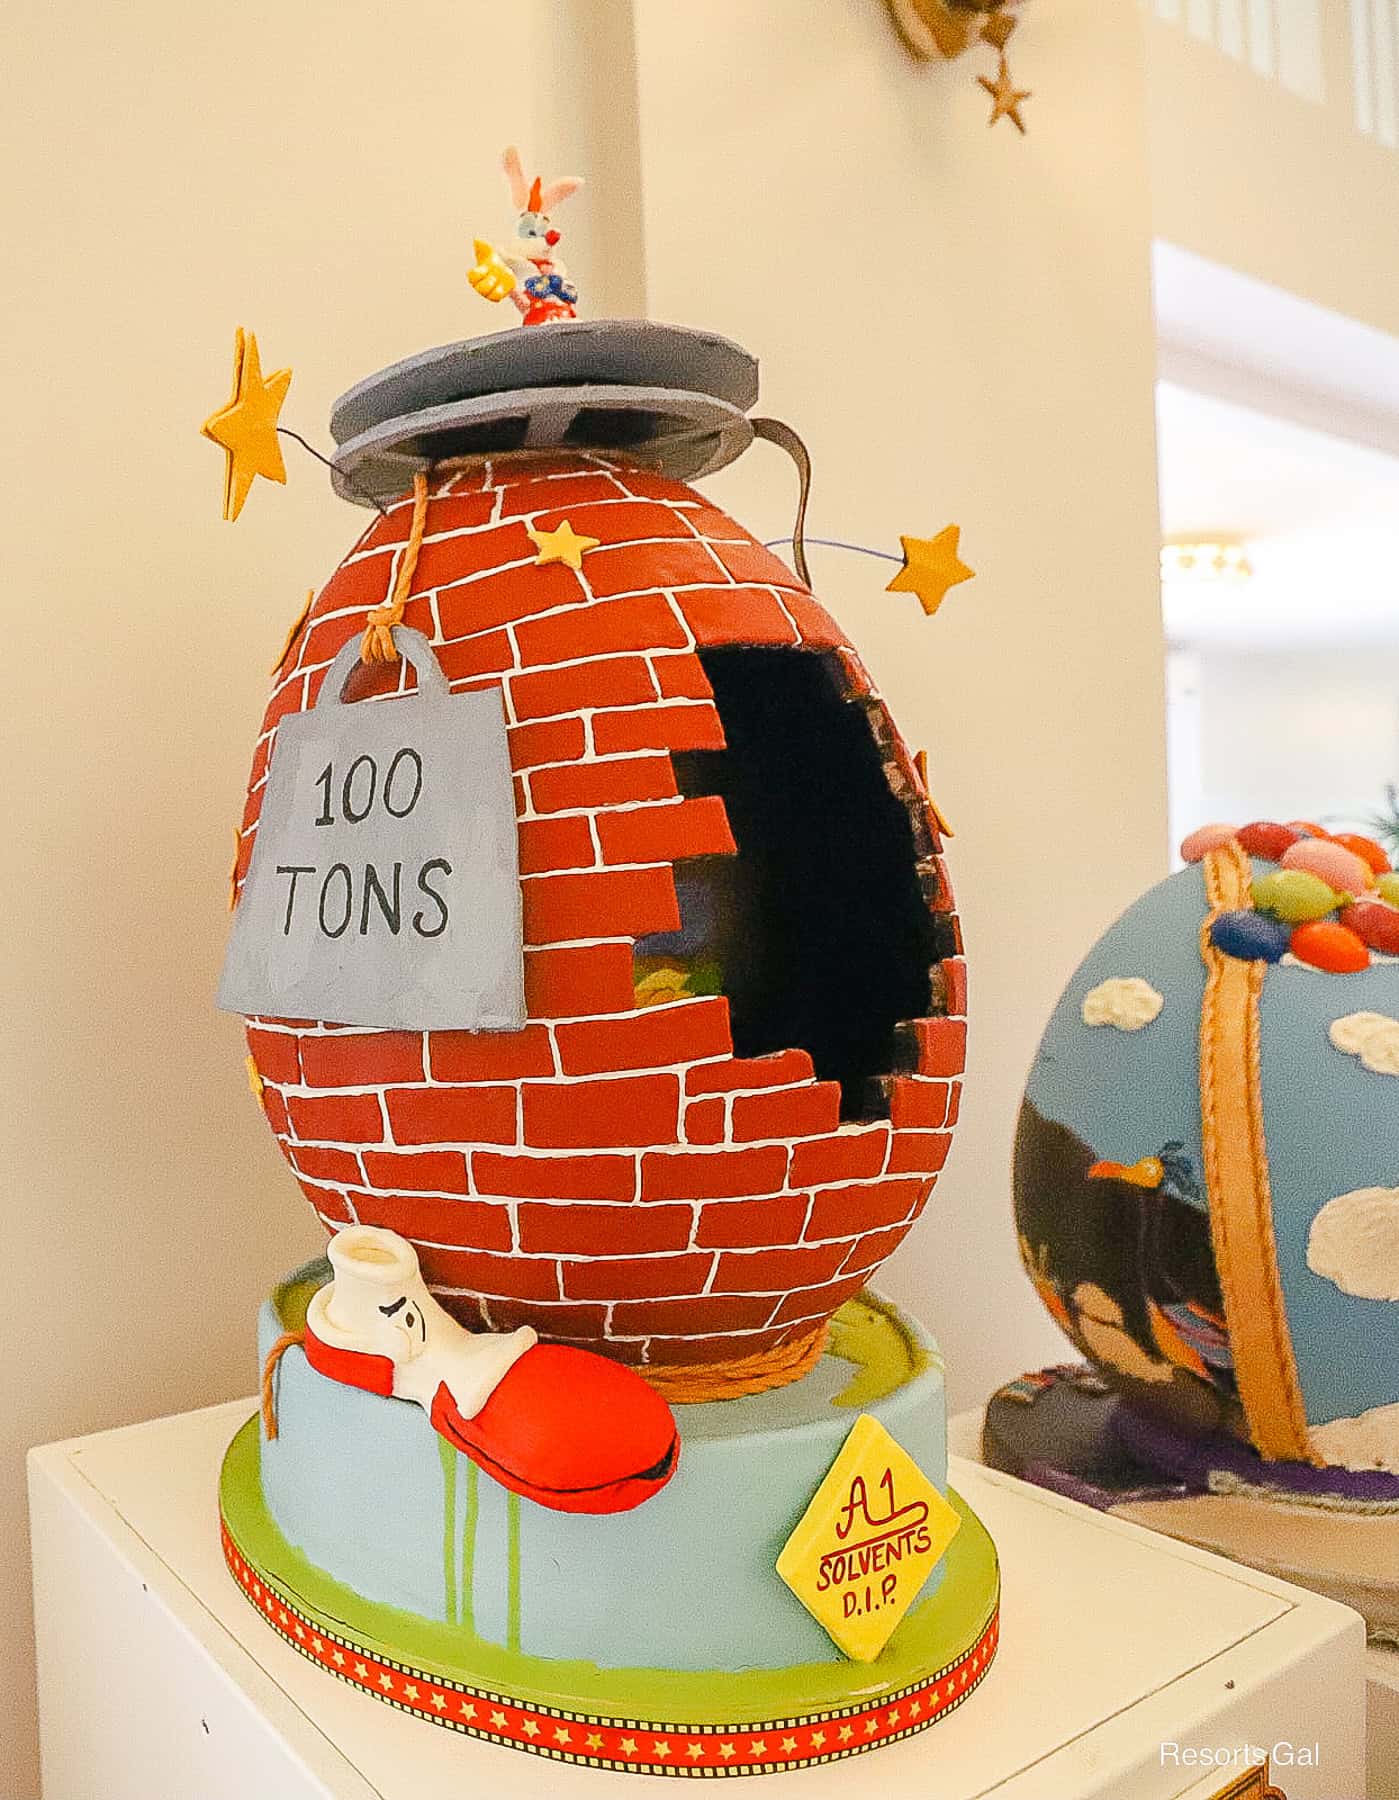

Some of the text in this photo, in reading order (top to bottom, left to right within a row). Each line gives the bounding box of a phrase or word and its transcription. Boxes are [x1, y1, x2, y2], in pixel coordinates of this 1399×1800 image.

[315, 747, 423, 826] 100
[276, 858, 453, 938] TONS
[817, 1526, 932, 1591] SOLVENTS
